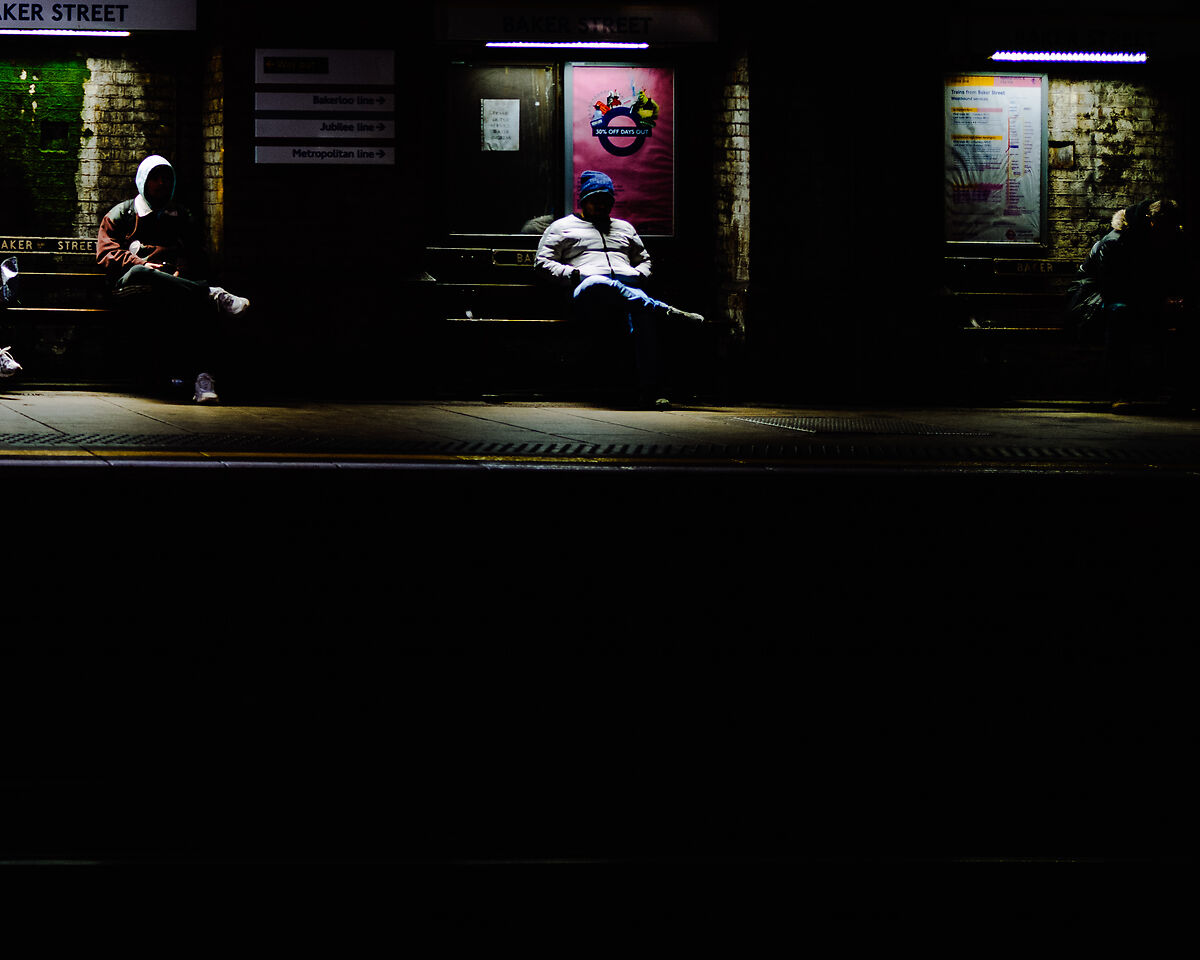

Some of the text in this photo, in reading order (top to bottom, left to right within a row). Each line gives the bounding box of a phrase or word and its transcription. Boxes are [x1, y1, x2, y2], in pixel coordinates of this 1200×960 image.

[51, 3, 129, 22] STREET
[503, 15, 653, 35] BAKER STREET
[313, 95, 374, 105] Bakerloo line
[319, 123, 374, 132] Jubilee line
[292, 149, 374, 160] Metropolitan line
[57, 240, 97, 252] STREE
